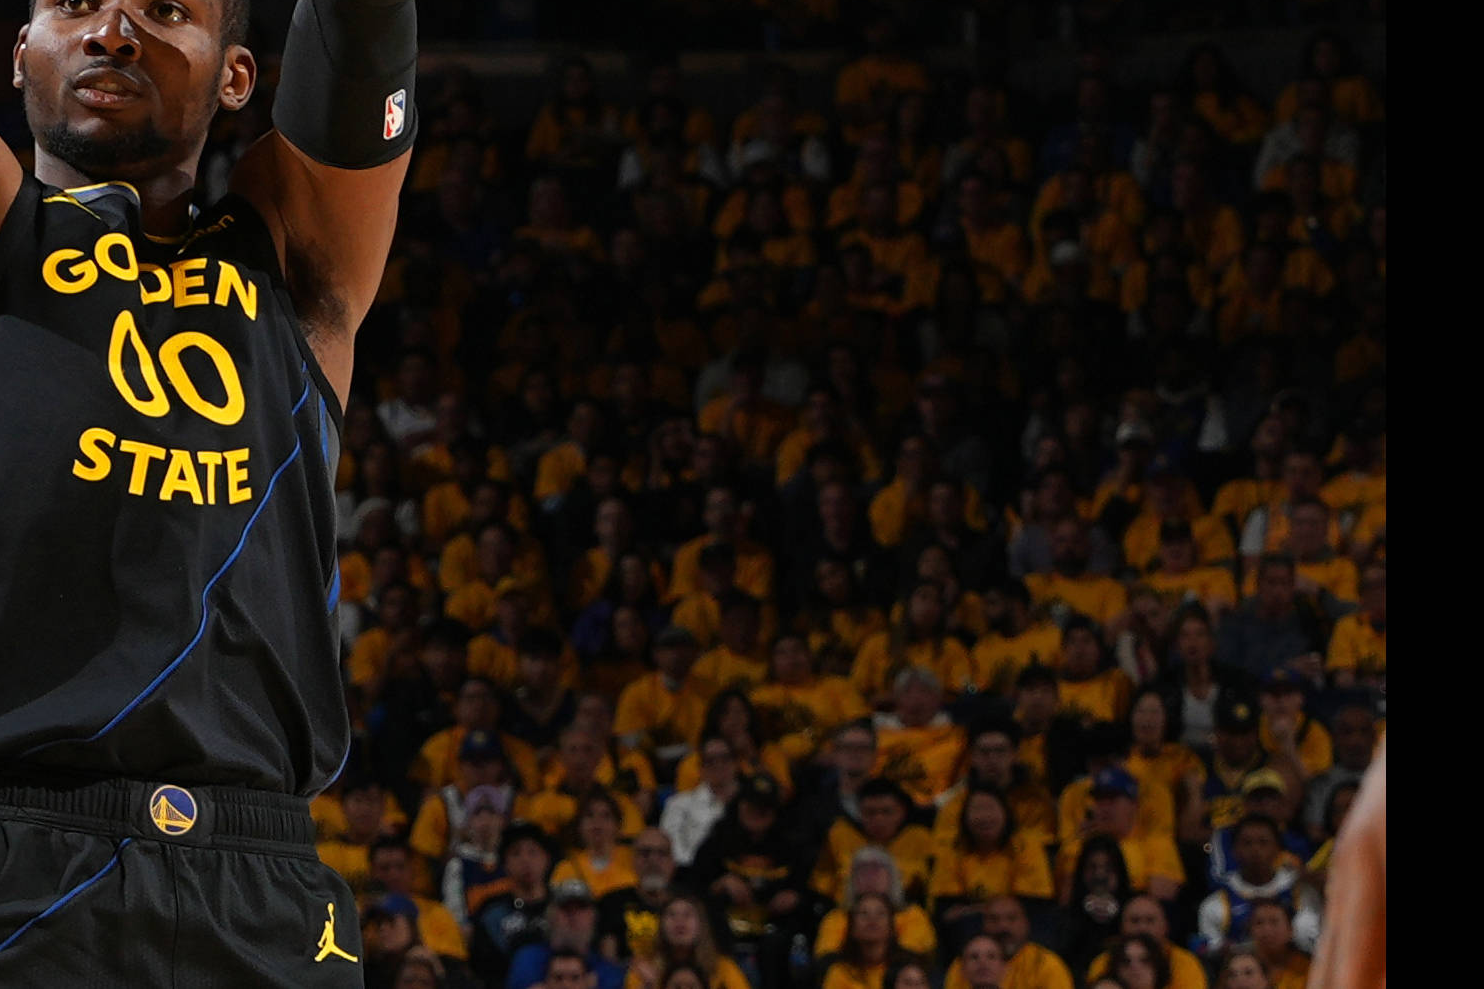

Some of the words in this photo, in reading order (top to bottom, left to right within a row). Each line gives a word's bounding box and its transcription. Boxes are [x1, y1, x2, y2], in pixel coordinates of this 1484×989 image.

[42, 232, 257, 321] GODEN
[108, 310, 246, 426] 00
[72, 427, 252, 505] STATE
